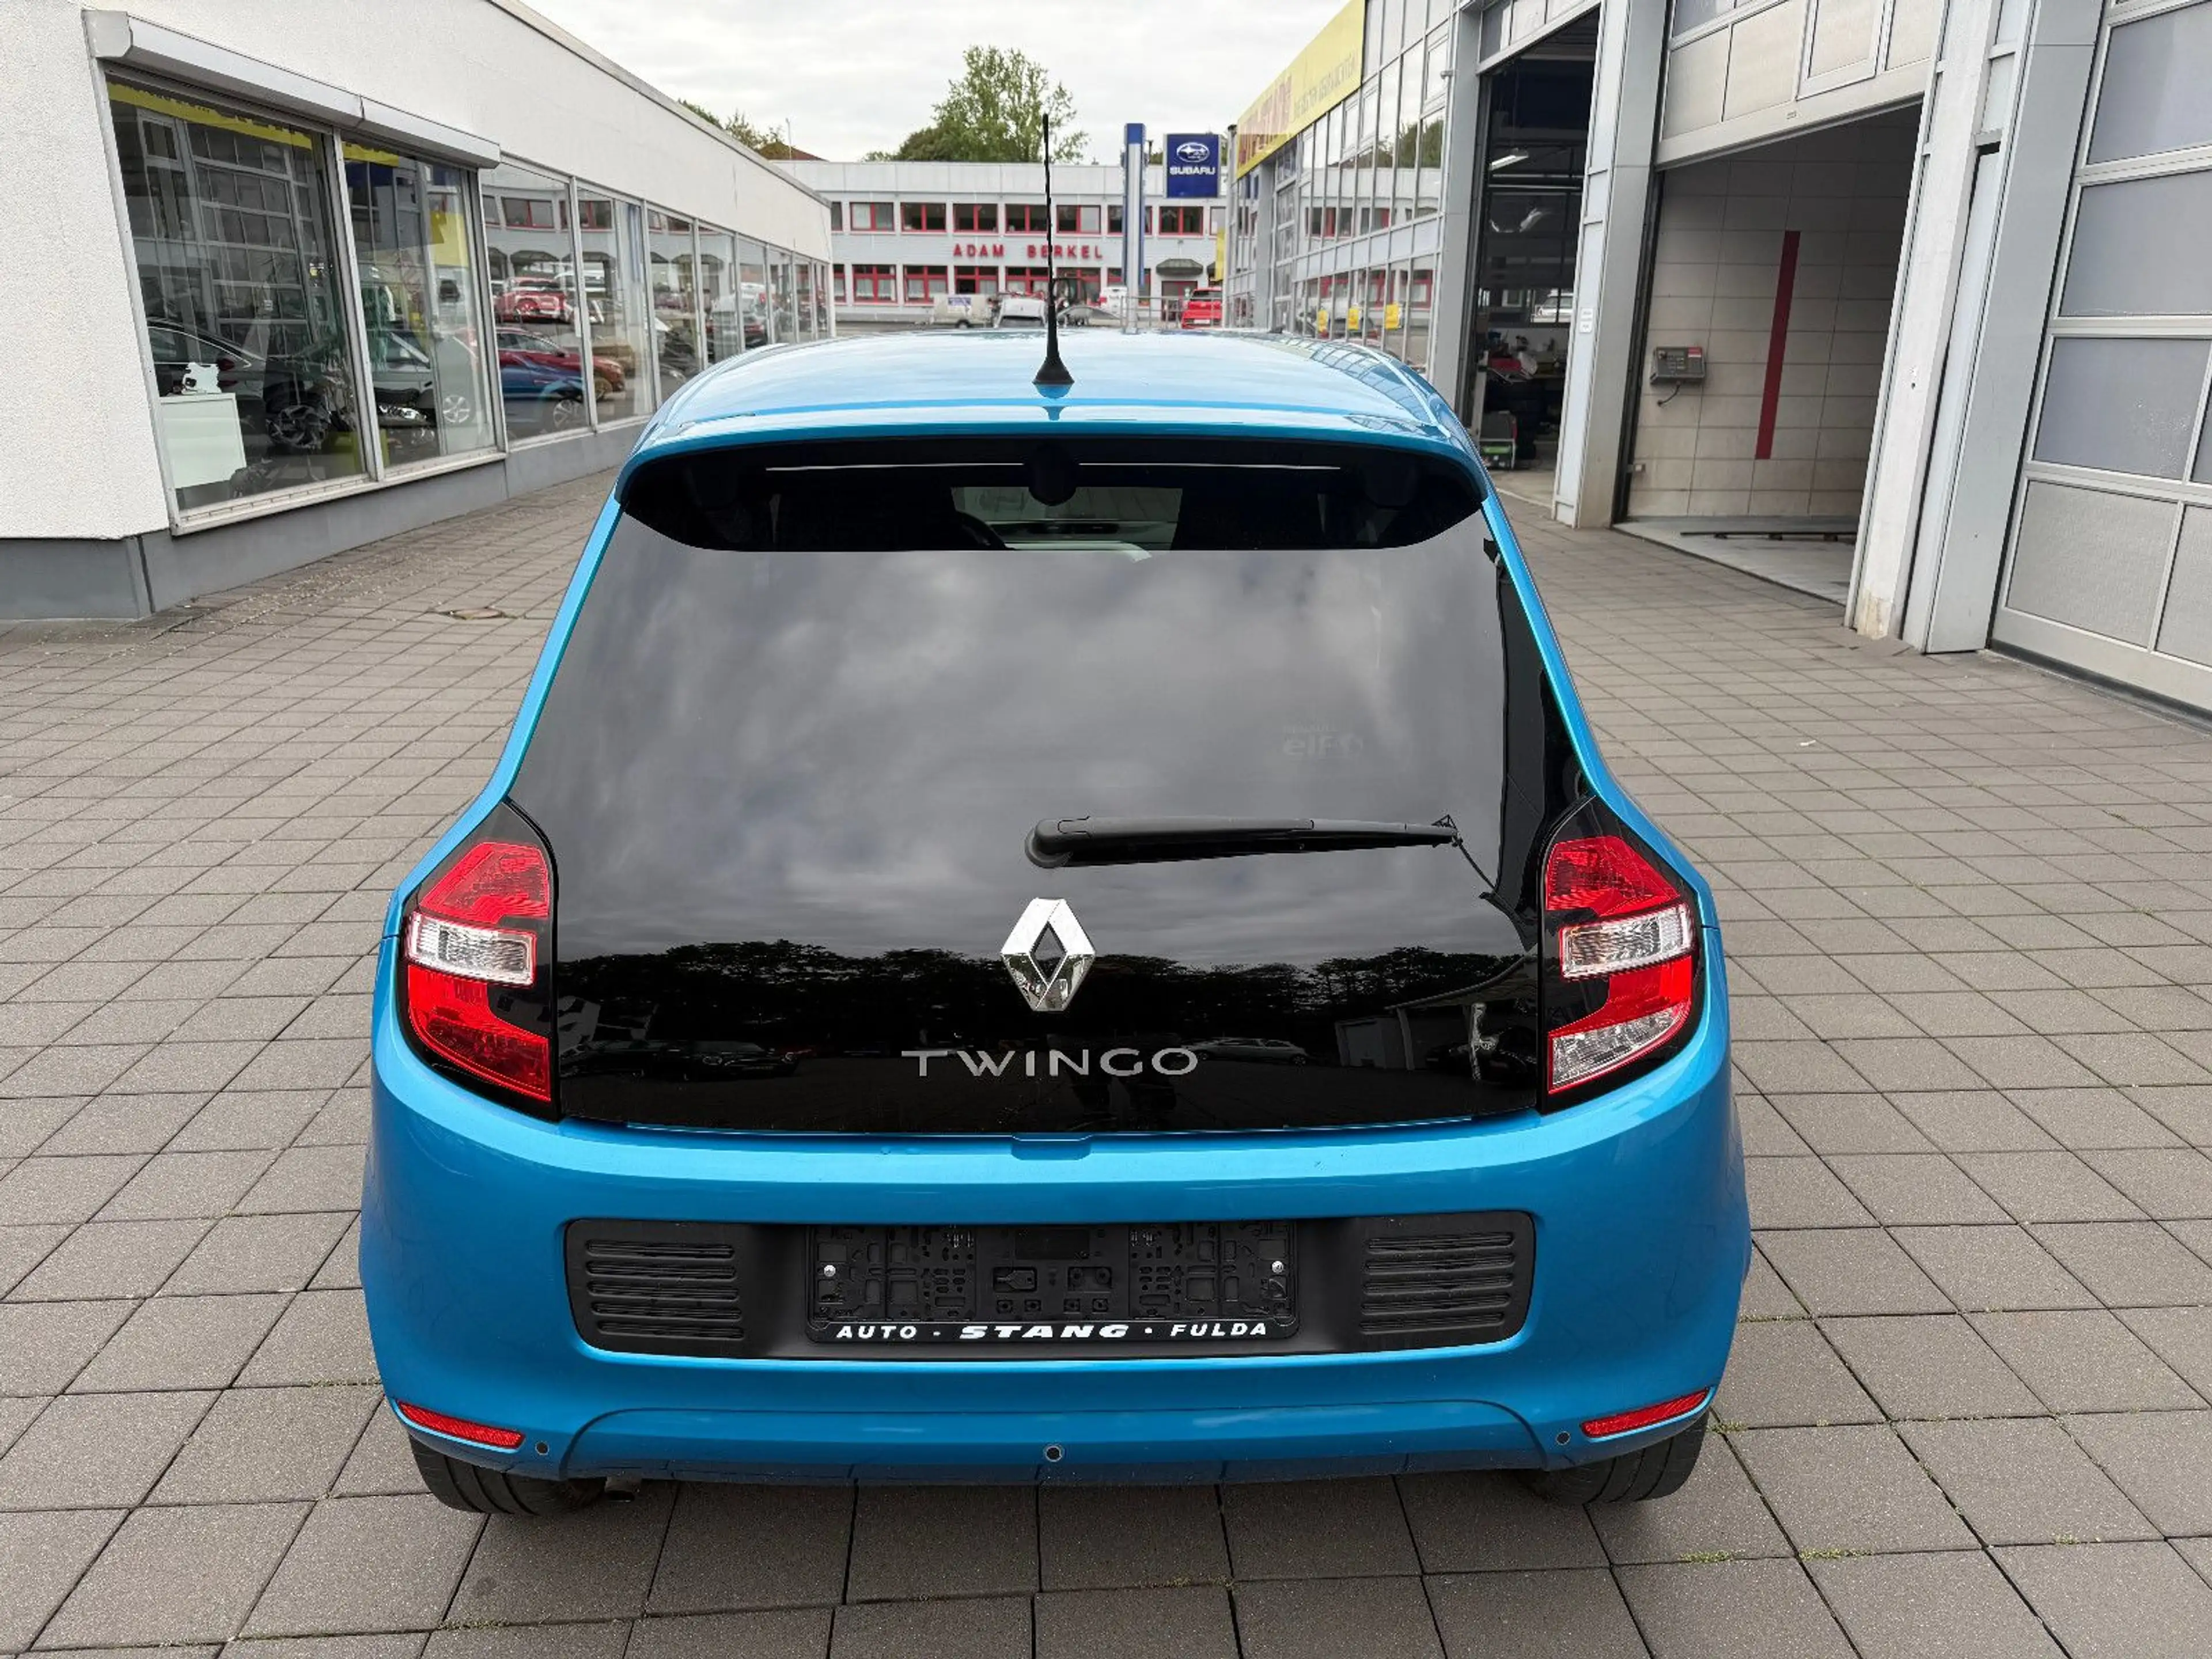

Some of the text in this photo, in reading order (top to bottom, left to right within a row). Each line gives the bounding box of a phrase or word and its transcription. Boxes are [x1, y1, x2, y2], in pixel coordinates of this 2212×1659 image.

[1170, 165, 1215, 175] SUBARU
[953, 244, 1103, 259] ADAM BERKEL
[901, 1048, 1198, 1077] TWINGO
[836, 1323, 1266, 1339] AUTO STANG FULDA
